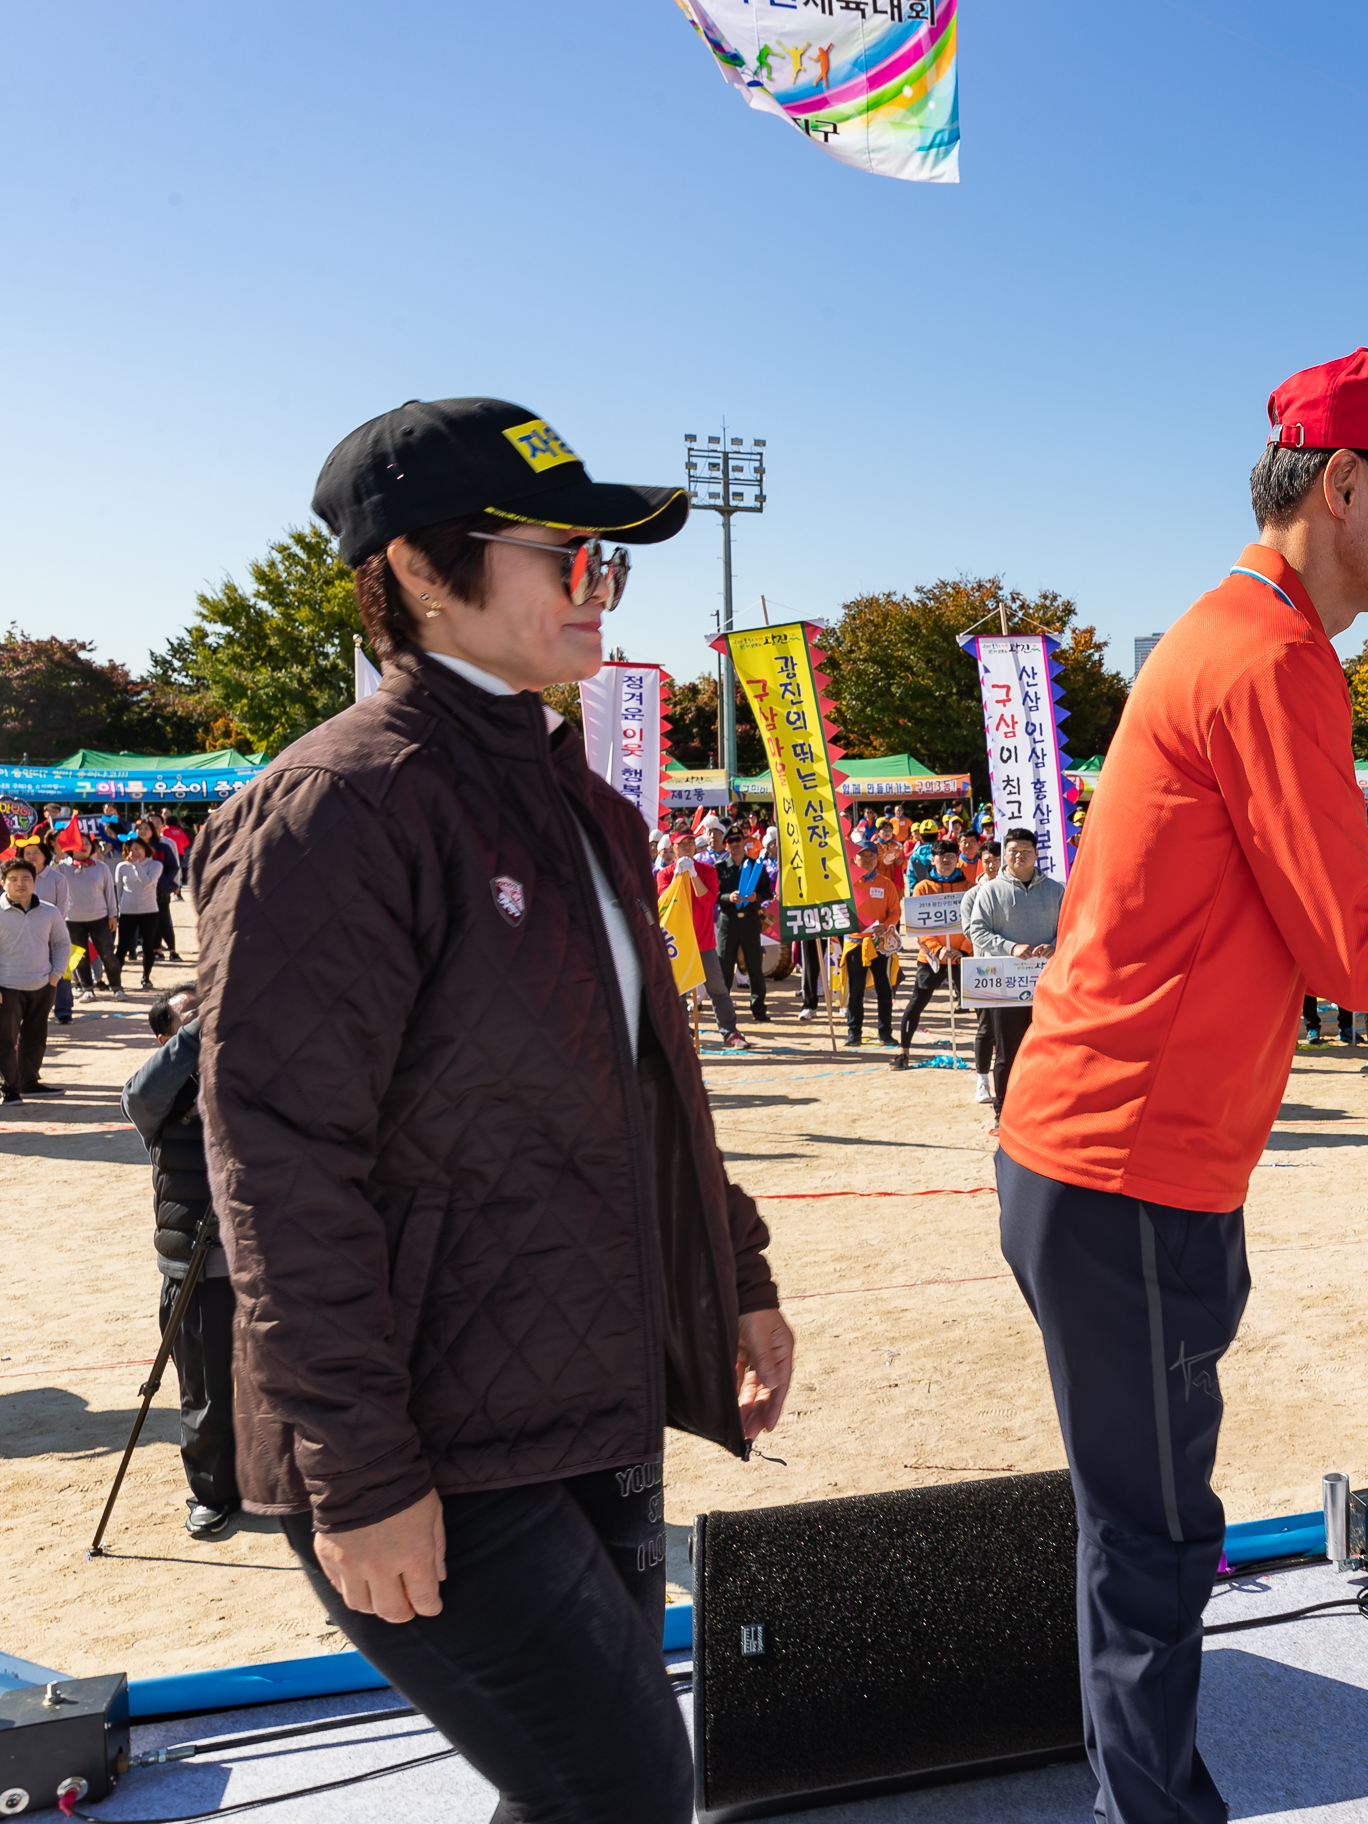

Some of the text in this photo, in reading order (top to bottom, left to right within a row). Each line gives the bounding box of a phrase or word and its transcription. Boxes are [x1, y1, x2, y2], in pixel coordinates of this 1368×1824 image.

[621, 675, 645, 722] 정겨운
[1019, 665, 1041, 712] 산삼
[773, 655, 808, 731] 광진의
[791, 742, 818, 791] 뛰는
[991, 684, 1018, 764] 구삼이
[621, 728, 644, 758] 이웃
[1025, 721, 1047, 769] 인삼
[75, 780, 148, 799] 구의1동
[866, 782, 913, 795] 만들어가는
[915, 780, 957, 794] 구의3동!
[1001, 774, 1023, 820] 최고
[786, 902, 851, 935] 구의3동
[917, 909, 962, 926] 구의3
[974, 977, 1002, 989] 2018
